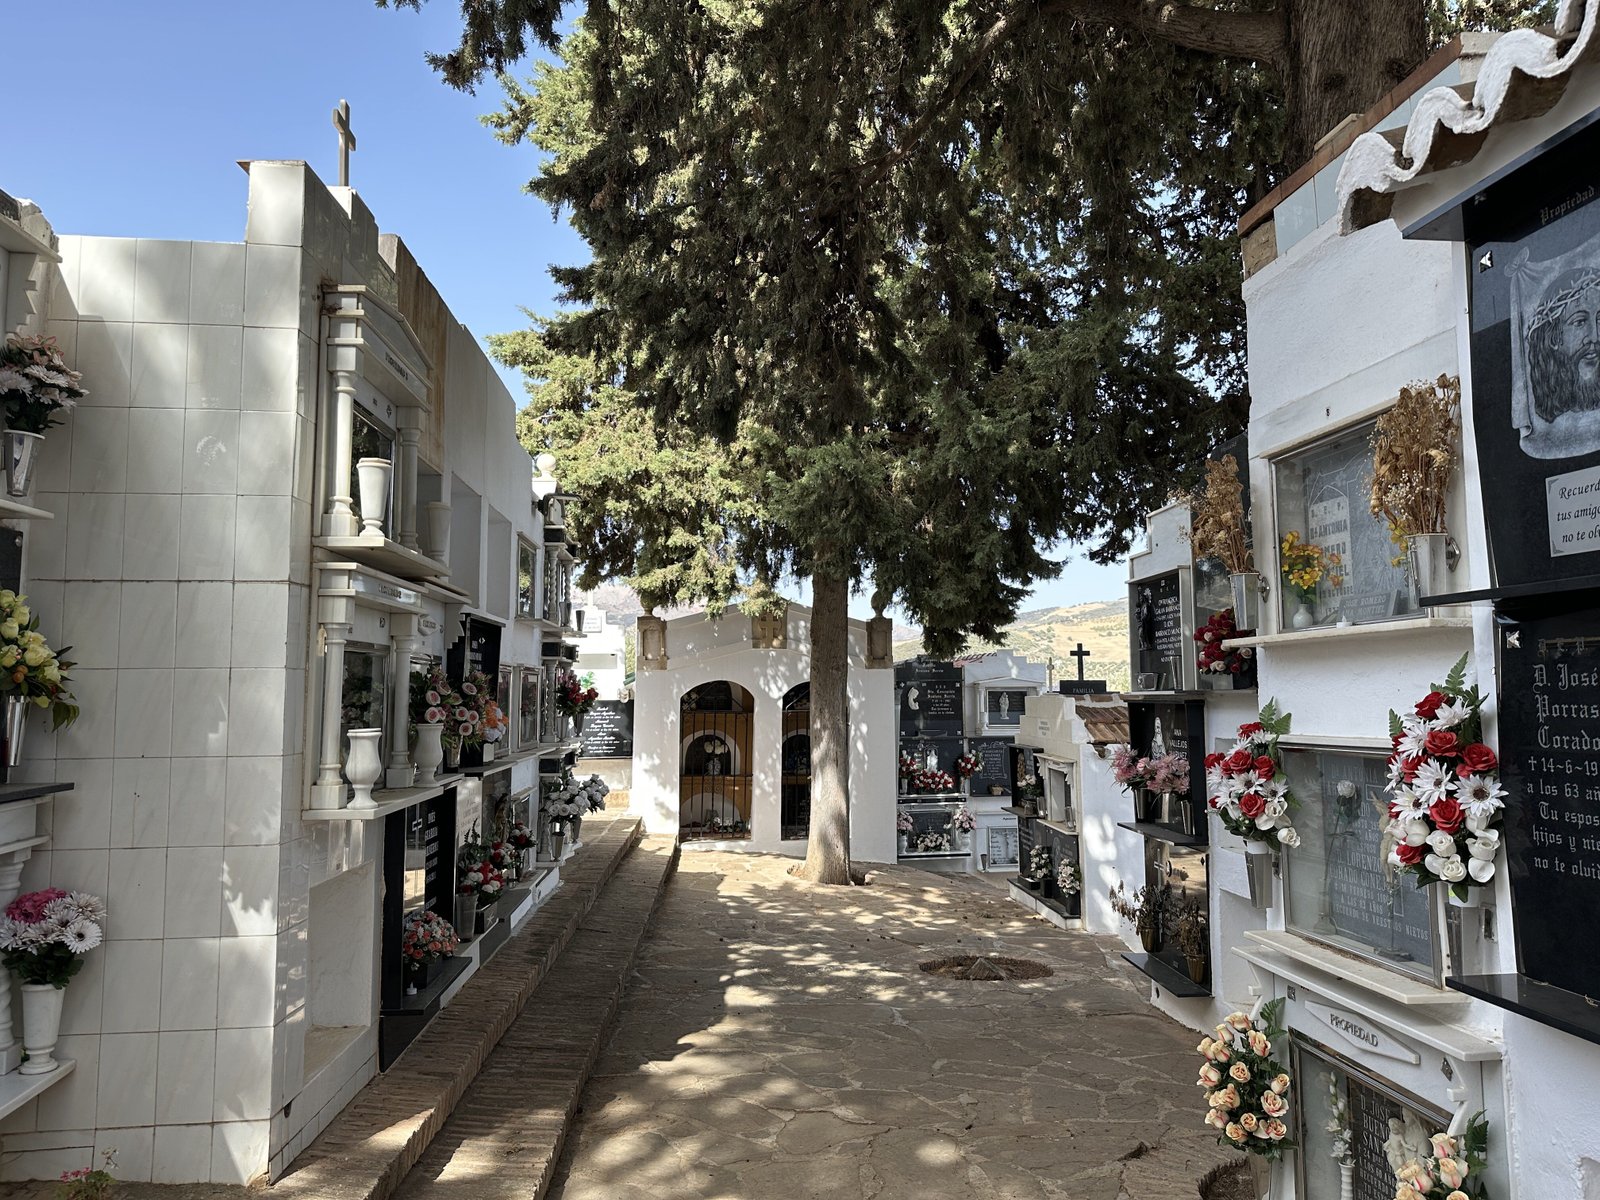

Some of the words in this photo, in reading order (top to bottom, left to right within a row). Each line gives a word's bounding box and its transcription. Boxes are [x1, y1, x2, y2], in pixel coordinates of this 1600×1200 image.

[1557, 509, 1572, 522] tus
[1562, 533, 1574, 543] no
[1577, 530, 1586, 541] te
[1532, 664, 1551, 694] D.
[1556, 663, 1599, 691] José
[1534, 694, 1600, 724] Porras
[1537, 725, 1600, 751] Corado
[1527, 782, 1534, 794] a
[1540, 779, 1558, 796] los
[1564, 783, 1579, 798] 63
[1539, 801, 1559, 821] Tu
[1564, 811, 1600, 829] espos
[1532, 824, 1562, 847] hijos
[1568, 836, 1577, 853] y
[1534, 857, 1549, 869] no
[1554, 857, 1566, 872] te
[1360, 871, 1387, 892] CONEJ
[1330, 1013, 1379, 1047] PROPIEDAD
